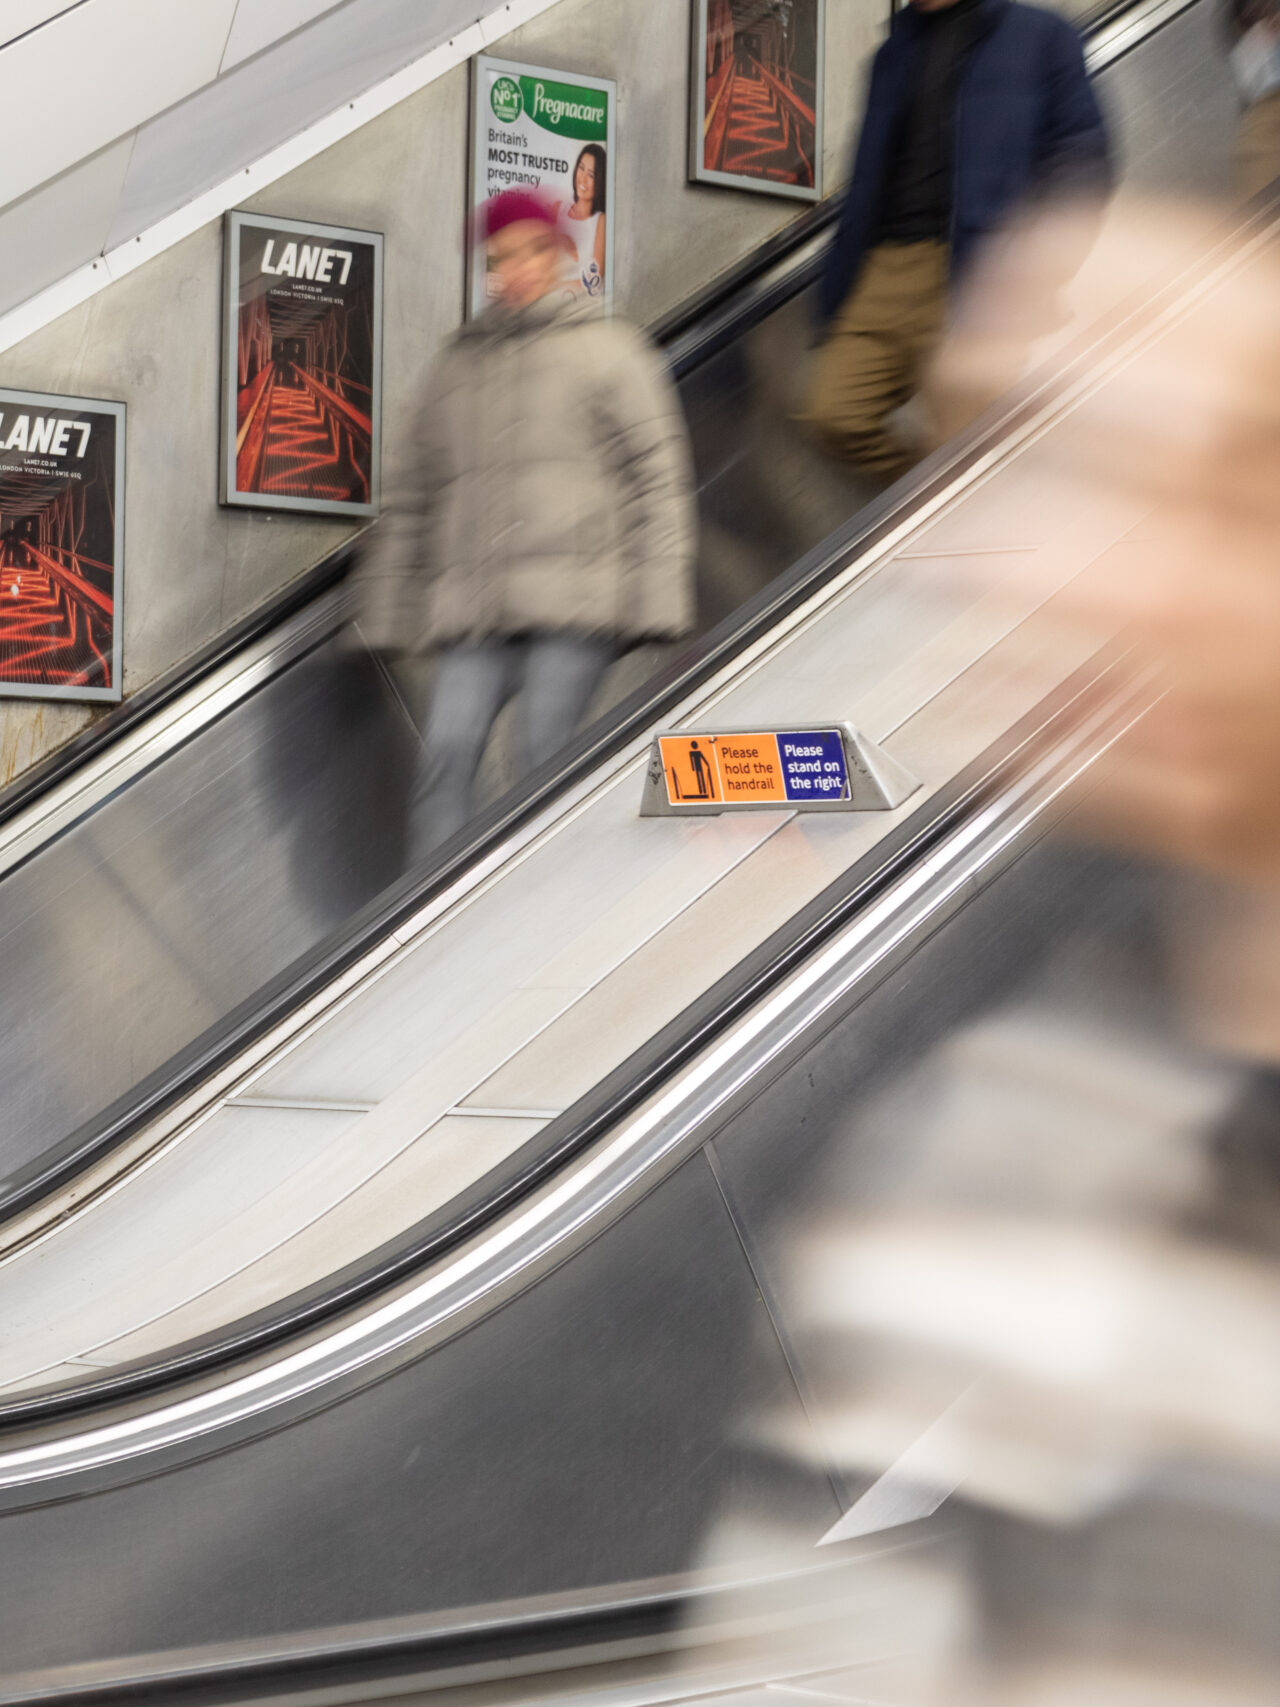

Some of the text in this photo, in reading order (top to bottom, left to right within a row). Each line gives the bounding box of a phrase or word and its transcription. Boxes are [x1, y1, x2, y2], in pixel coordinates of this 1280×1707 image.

[533, 83, 605, 125] Pregnacare
[488, 128, 528, 148] Britain's
[488, 148, 569, 173] MOST TRUSTED
[488, 167, 541, 189] pregnancy
[261, 239, 353, 285] LANE7
[721, 747, 759, 759] Please
[784, 744, 823, 757] Please
[725, 763, 774, 774] hold the
[787, 760, 840, 773] stand on
[727, 778, 775, 790] handrail
[791, 775, 842, 791] the right
